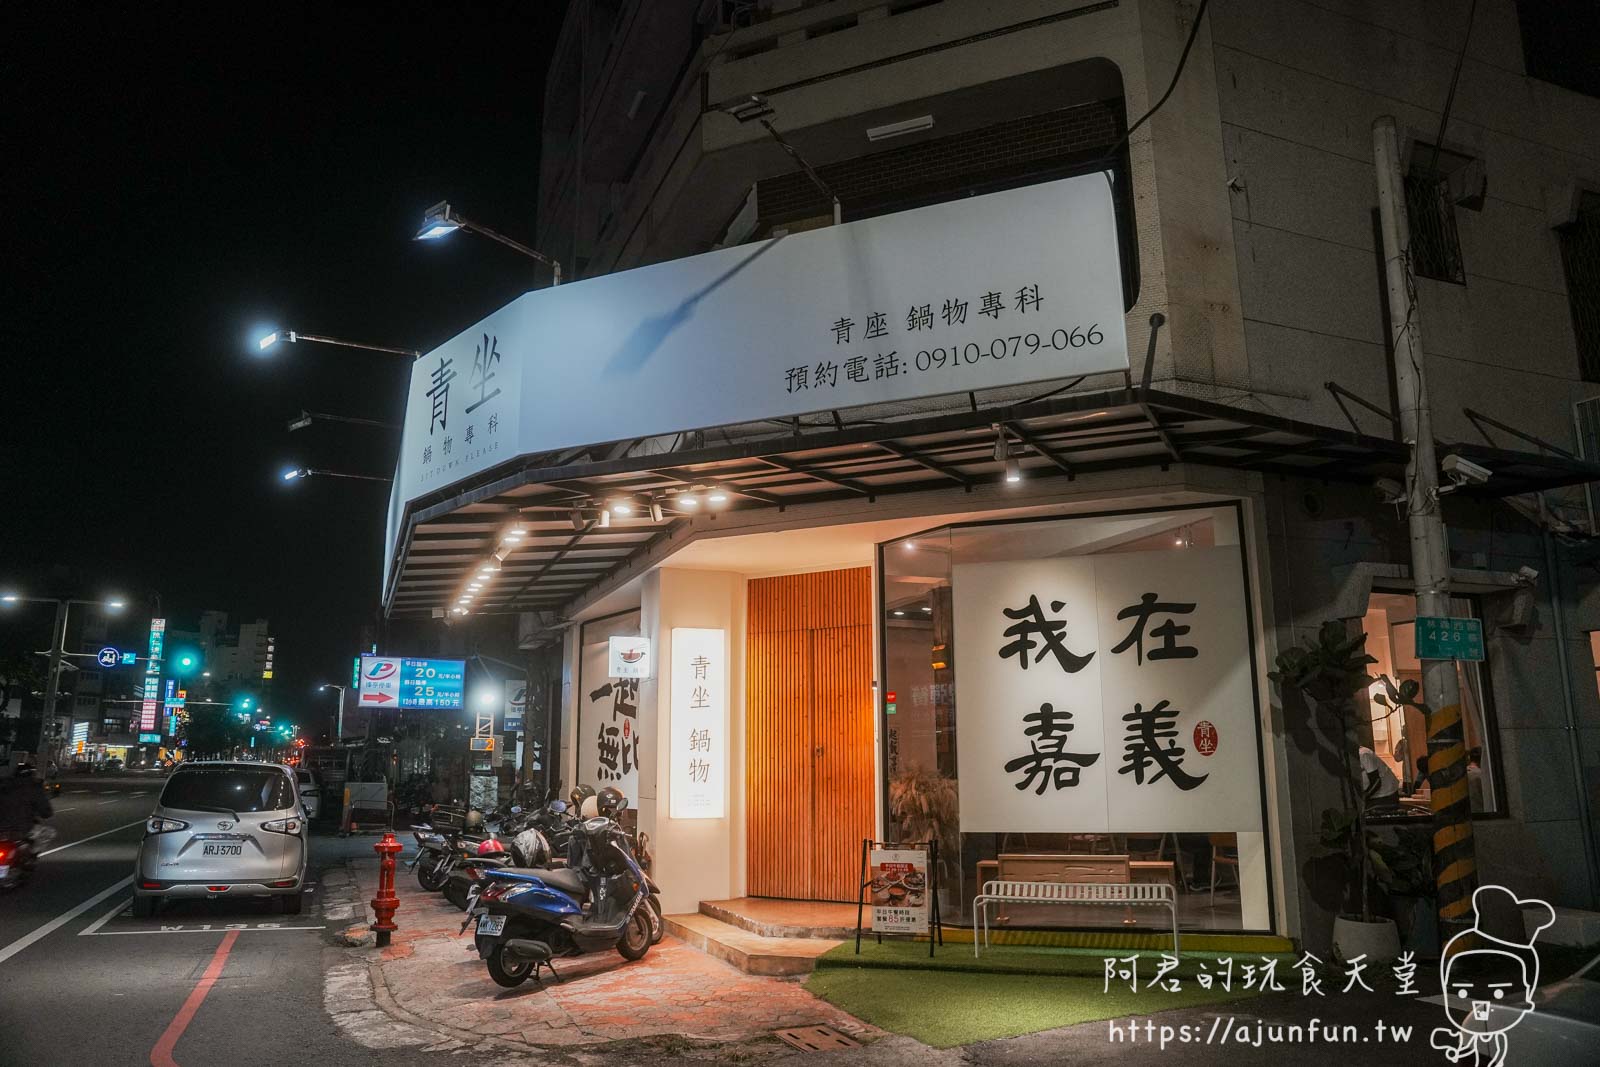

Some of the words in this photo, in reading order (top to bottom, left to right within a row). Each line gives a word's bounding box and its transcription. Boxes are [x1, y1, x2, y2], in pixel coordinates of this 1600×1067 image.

[831, 312, 889, 344] 青座
[906, 284, 1044, 332] 鍋物專科
[426, 332, 501, 436] 青坐
[785, 351, 908, 394] 預約電話:
[915, 323, 1104, 372] 0910-079-066
[422, 412, 498, 465] 鍋物專科
[998, 592, 1199, 673] 我在
[1428, 631, 1461, 641] 426
[414, 686, 435, 696] 25
[415, 668, 436, 678] 20
[689, 655, 711, 709] 青坐
[688, 728, 711, 783] 鍋物
[1004, 699, 1209, 795] 嘉義
[203, 845, 242, 856] ARJ-3700
